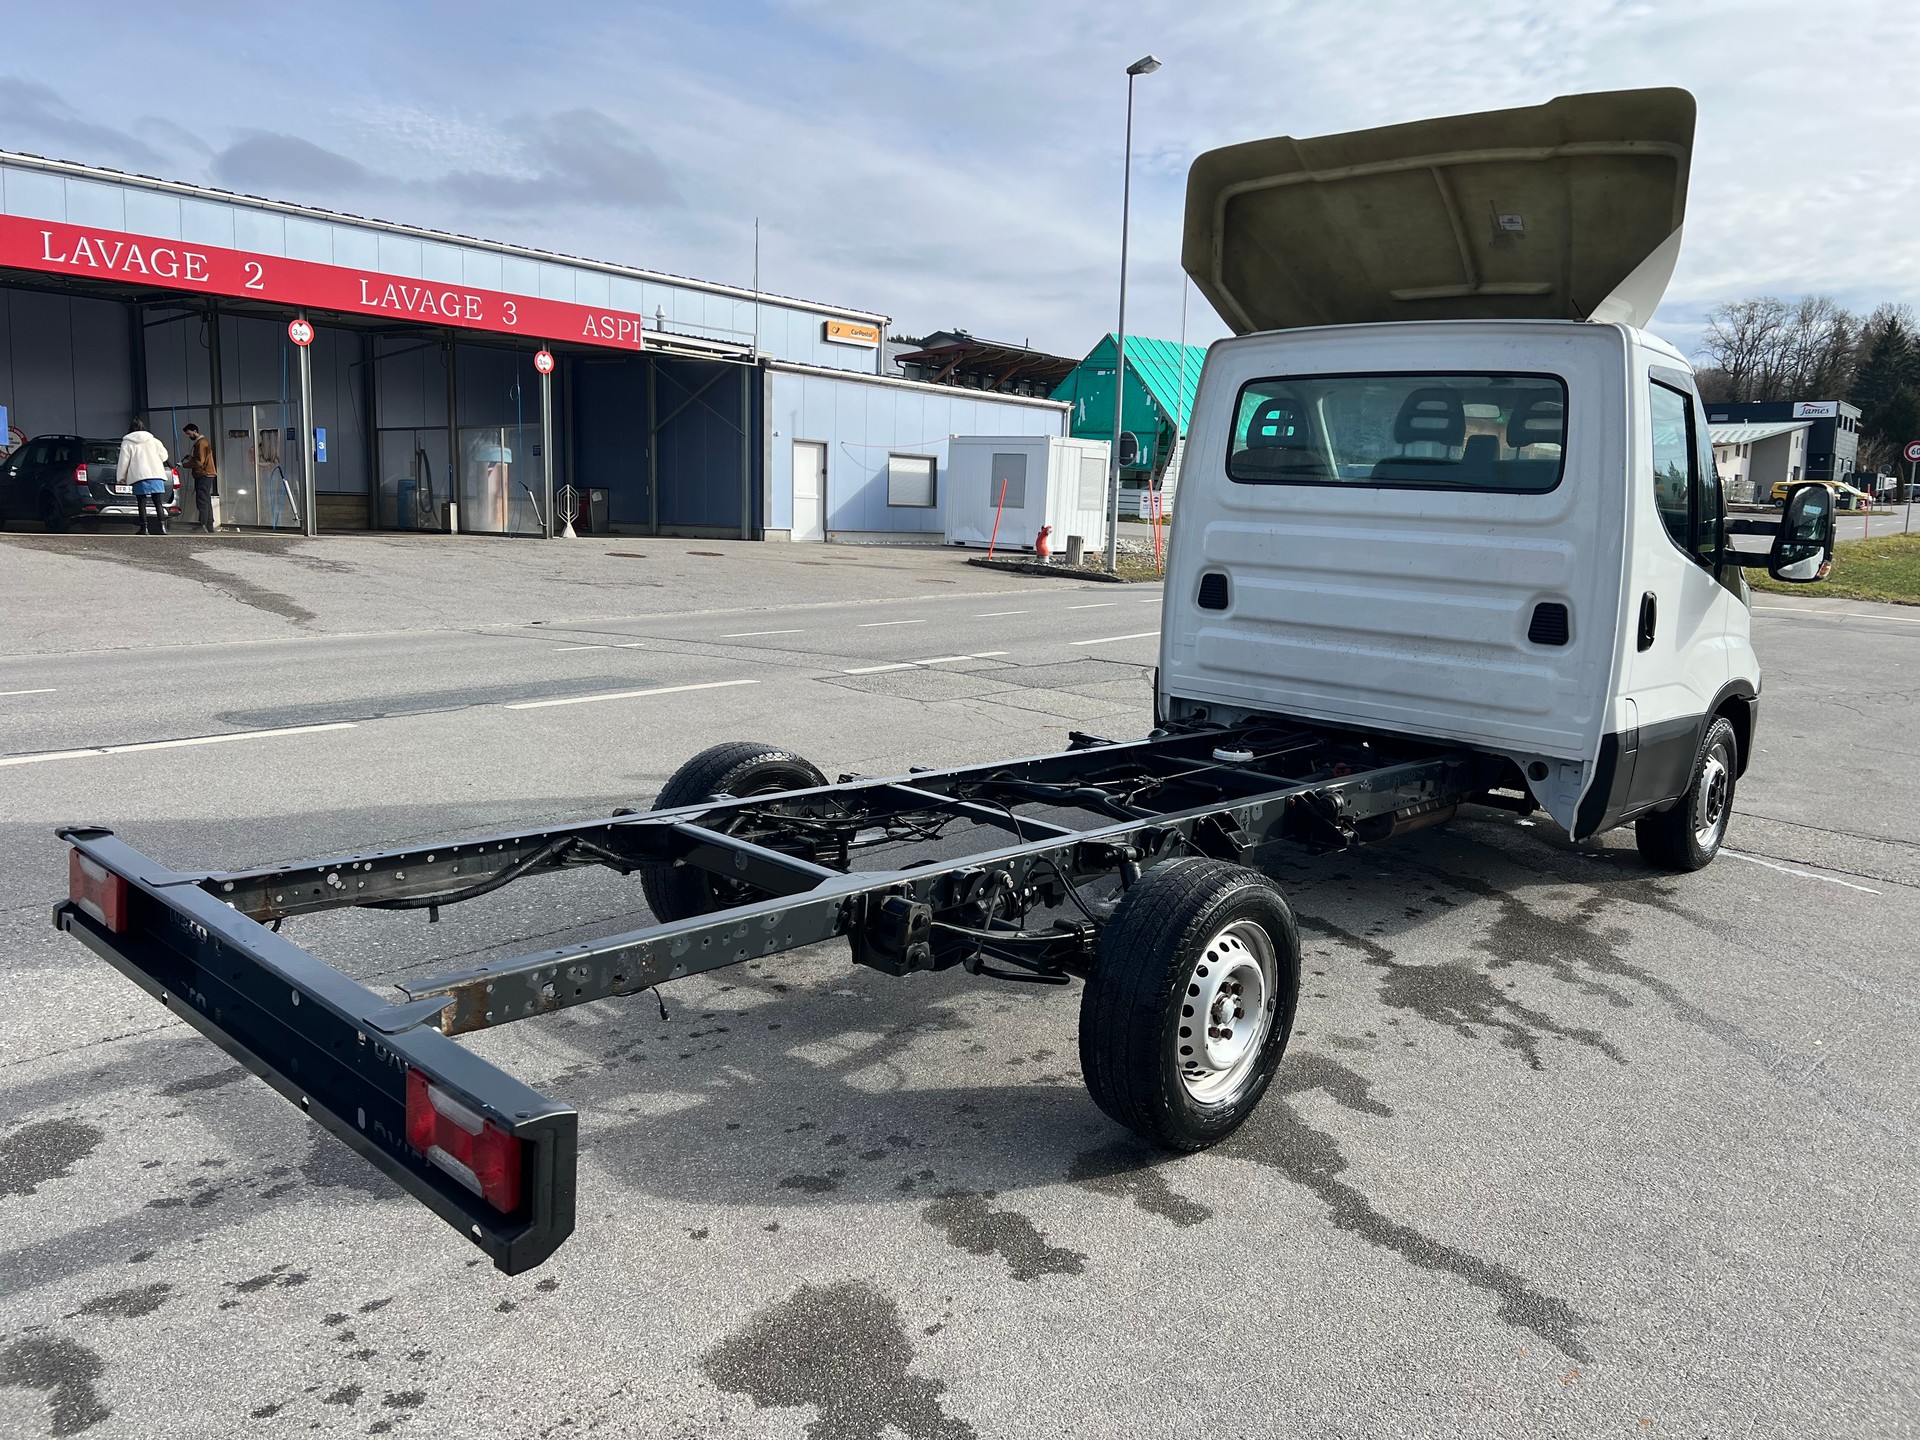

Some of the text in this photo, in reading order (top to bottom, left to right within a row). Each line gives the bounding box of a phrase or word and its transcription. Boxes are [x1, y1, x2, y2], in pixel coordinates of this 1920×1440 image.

[40, 230, 265, 290] LAVAGE 2
[359, 279, 517, 325] LAVAGE 3
[582, 314, 640, 343] ASPI
[850, 328, 873, 338] CarPostal
[1800, 407, 1830, 416] James
[318, 441, 325, 450] 3
[1199, 896, 1239, 939] UNIROYAL
